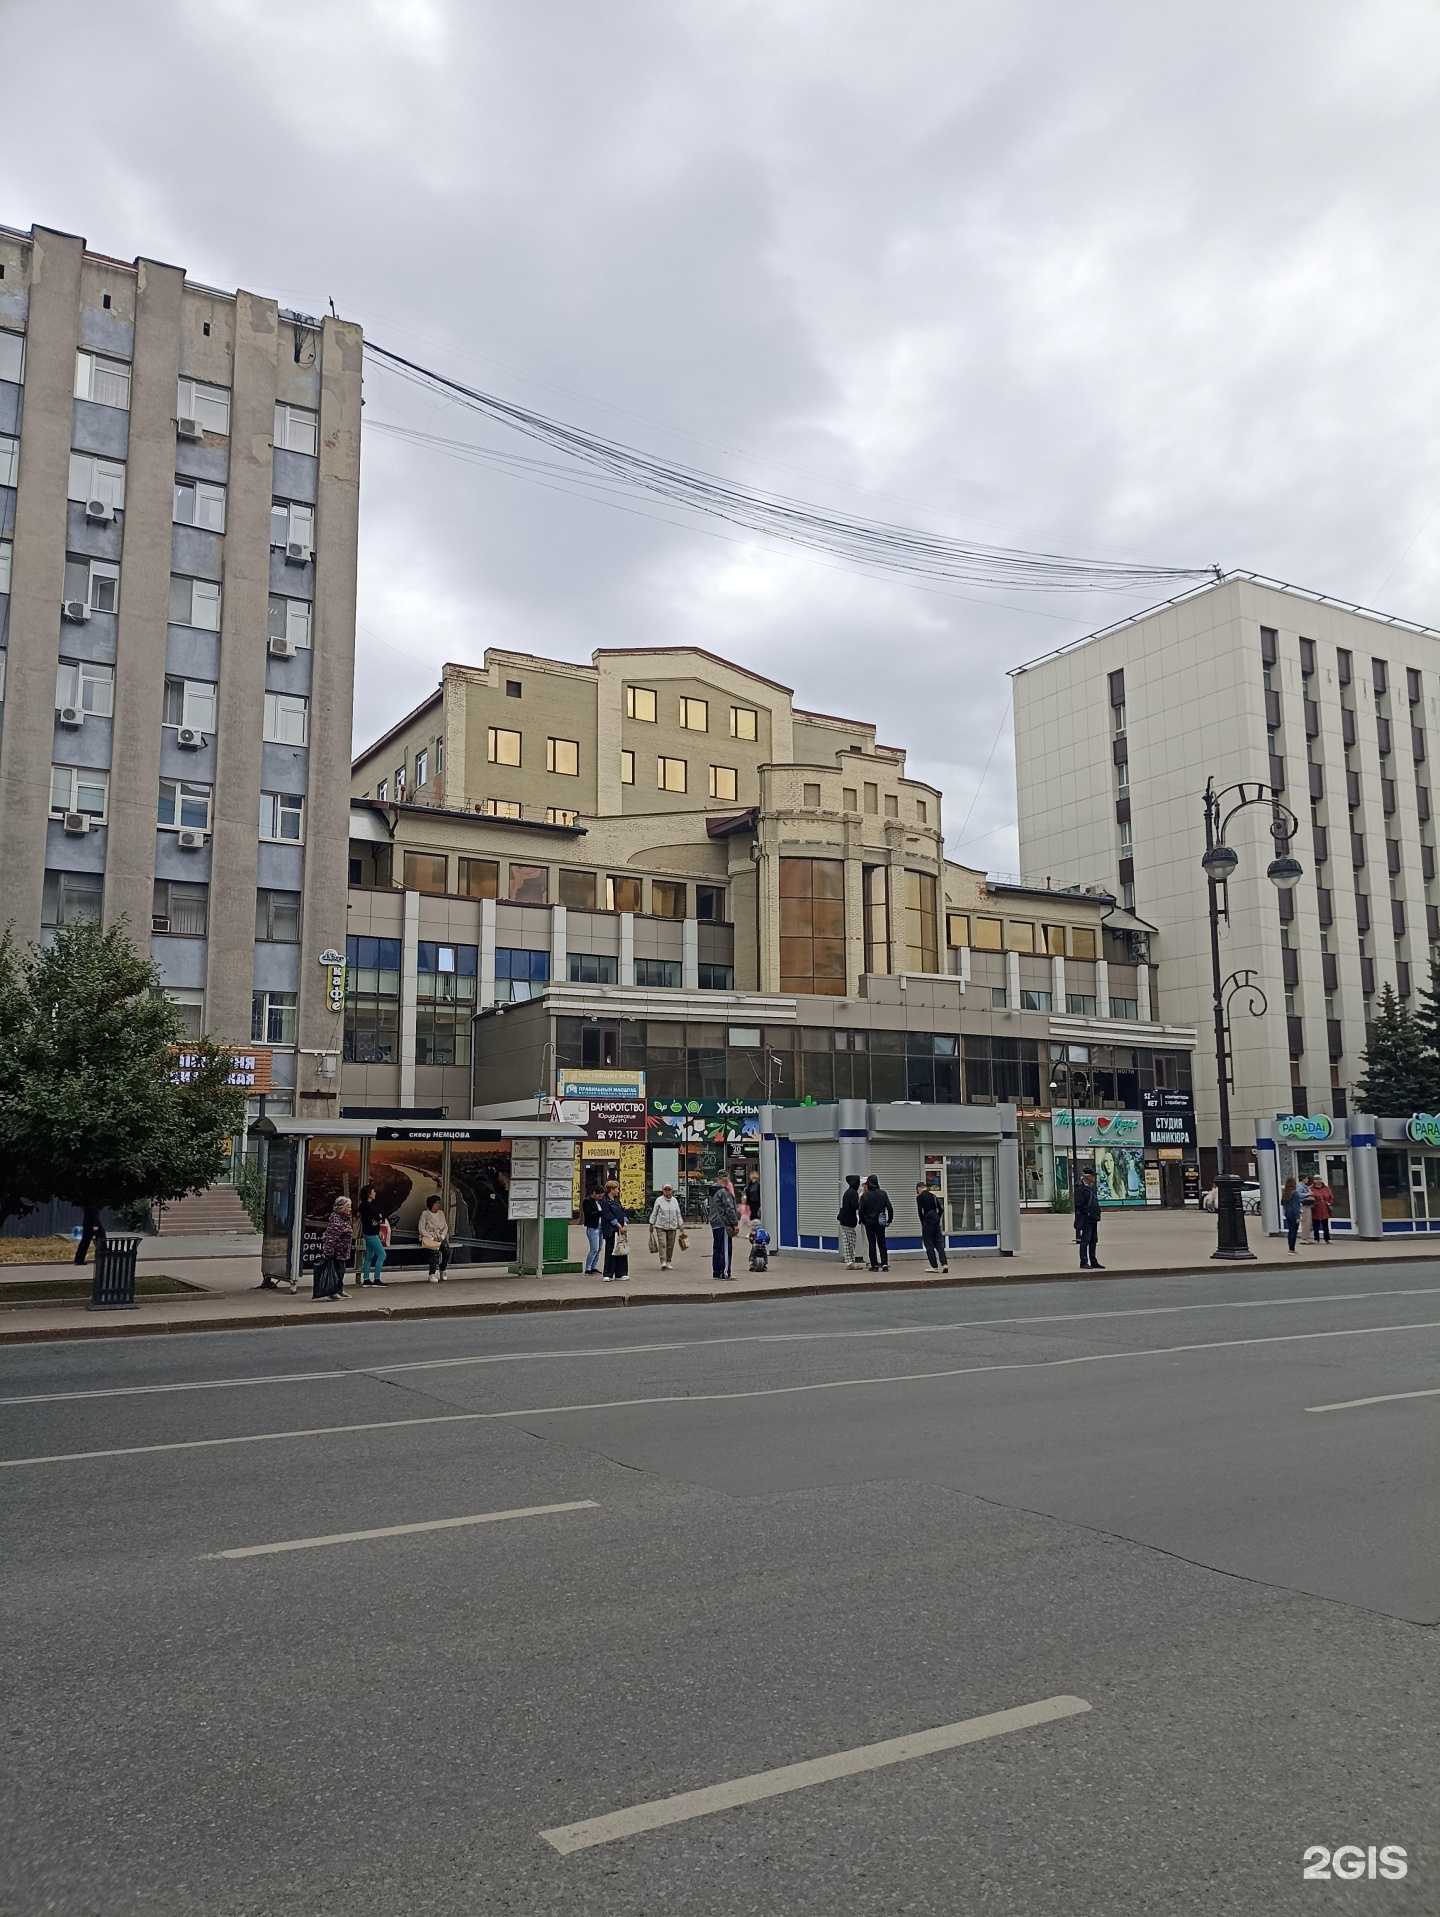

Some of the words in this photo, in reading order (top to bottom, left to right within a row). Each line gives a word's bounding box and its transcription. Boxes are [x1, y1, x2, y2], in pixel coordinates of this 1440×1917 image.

[590, 1103, 644, 1112] БАНКРОТСТВО
[1155, 1117, 1183, 1130] СТУДИЯ
[433, 1131, 470, 1140] НЕМЦОВА
[608, 1130, 638, 1139] 912-112
[1150, 1131, 1190, 1143] МАНИКЮРА
